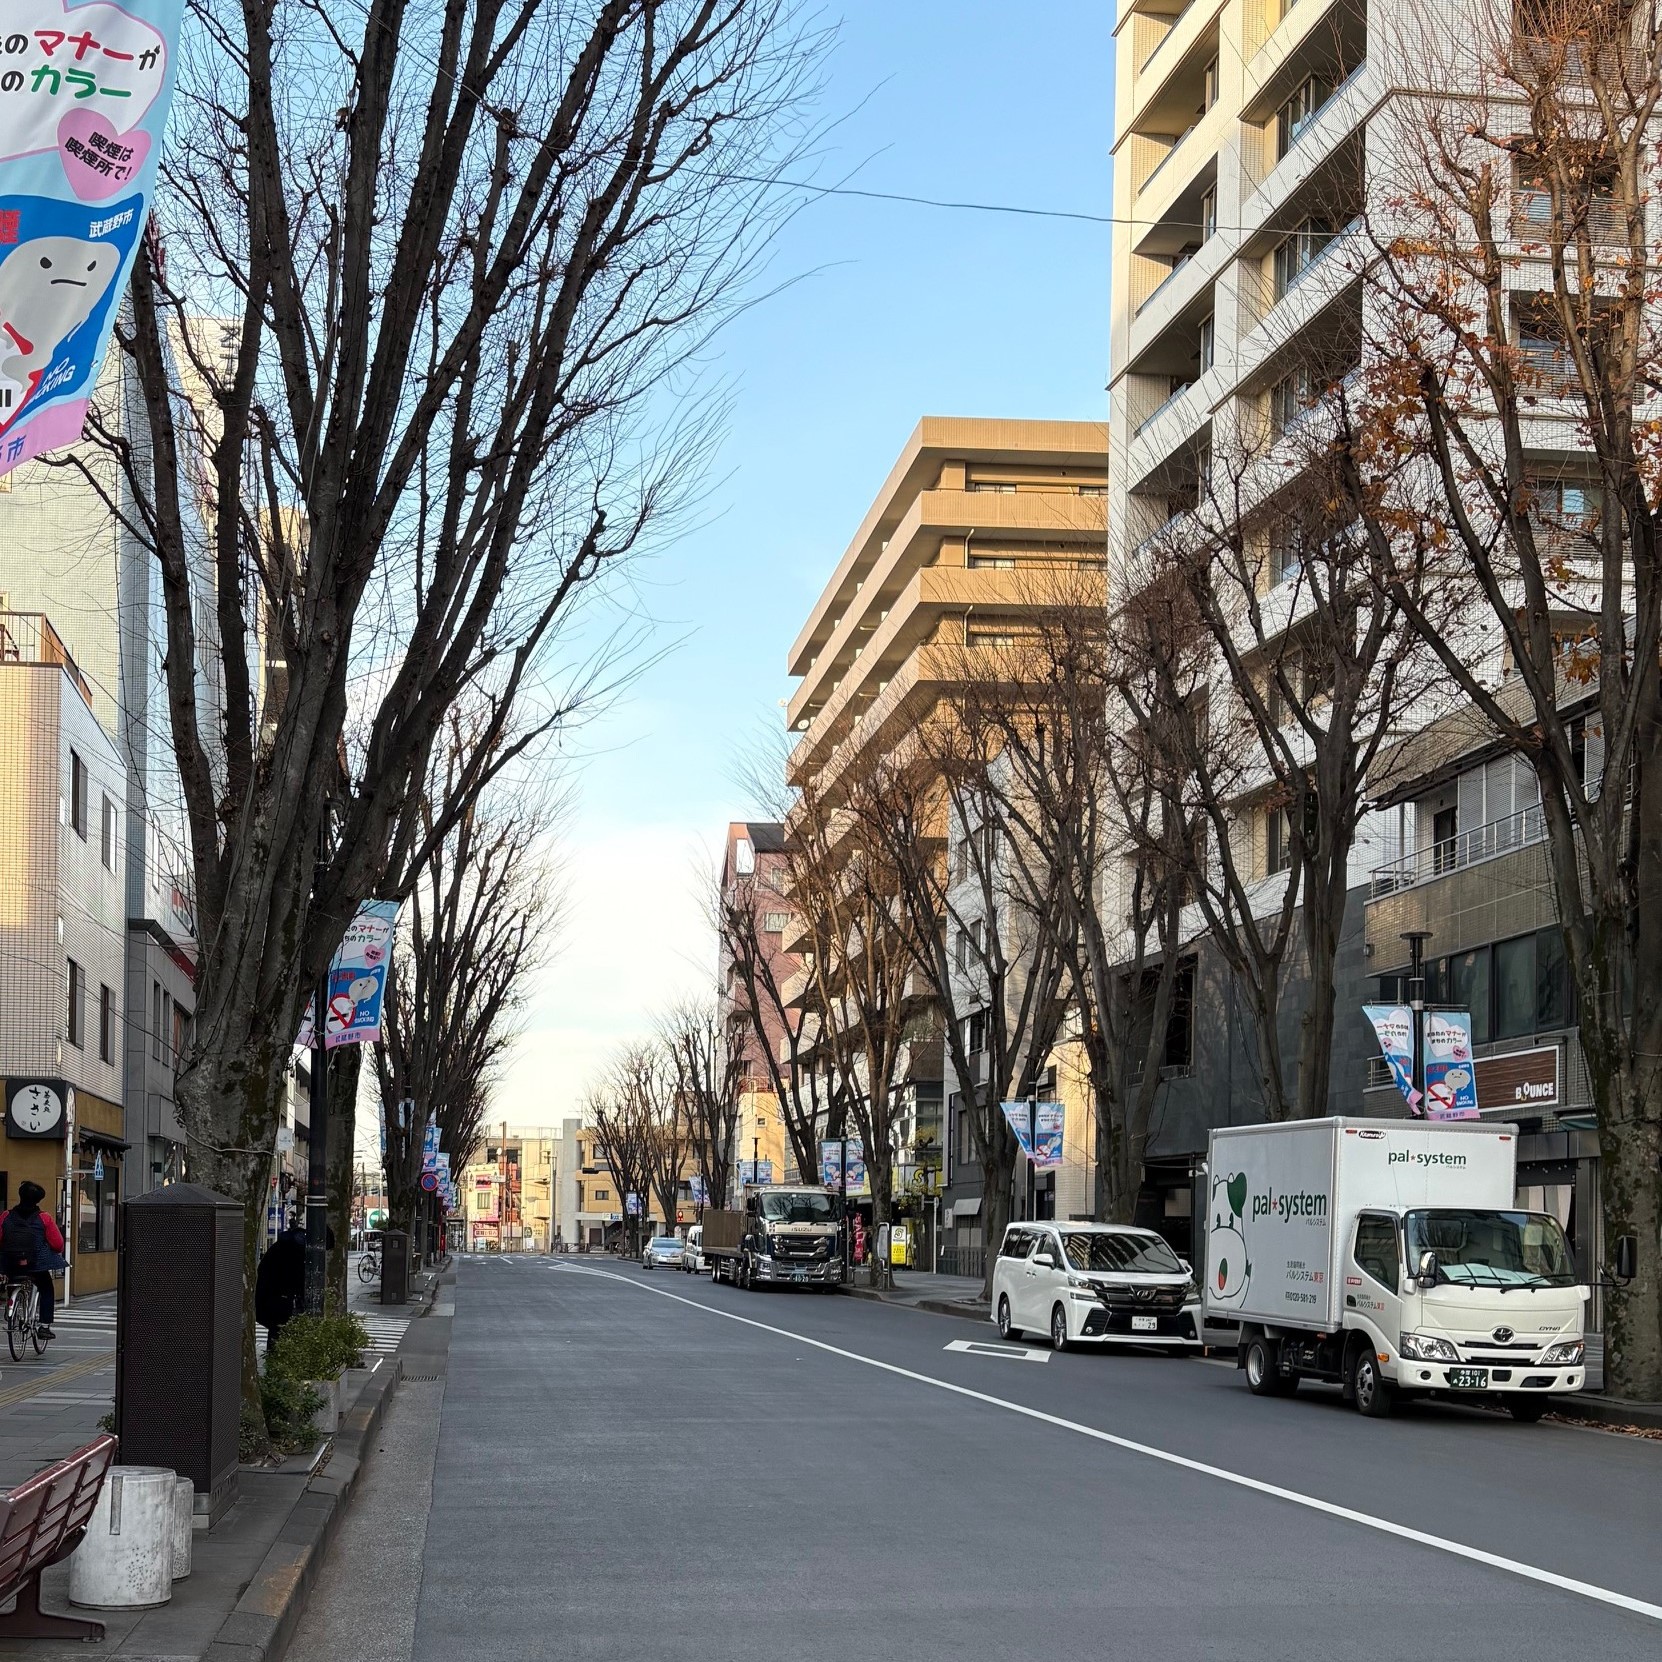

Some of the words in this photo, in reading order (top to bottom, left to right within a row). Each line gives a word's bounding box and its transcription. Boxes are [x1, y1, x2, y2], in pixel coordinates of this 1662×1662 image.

[0, 30, 161, 71] のマナーが
[1, 64, 132, 99] のカラー
[64, 136, 133, 181] 喫煙所で!
[88, 131, 135, 163] 喫煙は
[88, 208, 135, 239] 武蔵野市
[42, 356, 70, 387] NO
[1515, 1082, 1554, 1100] BOUNCE
